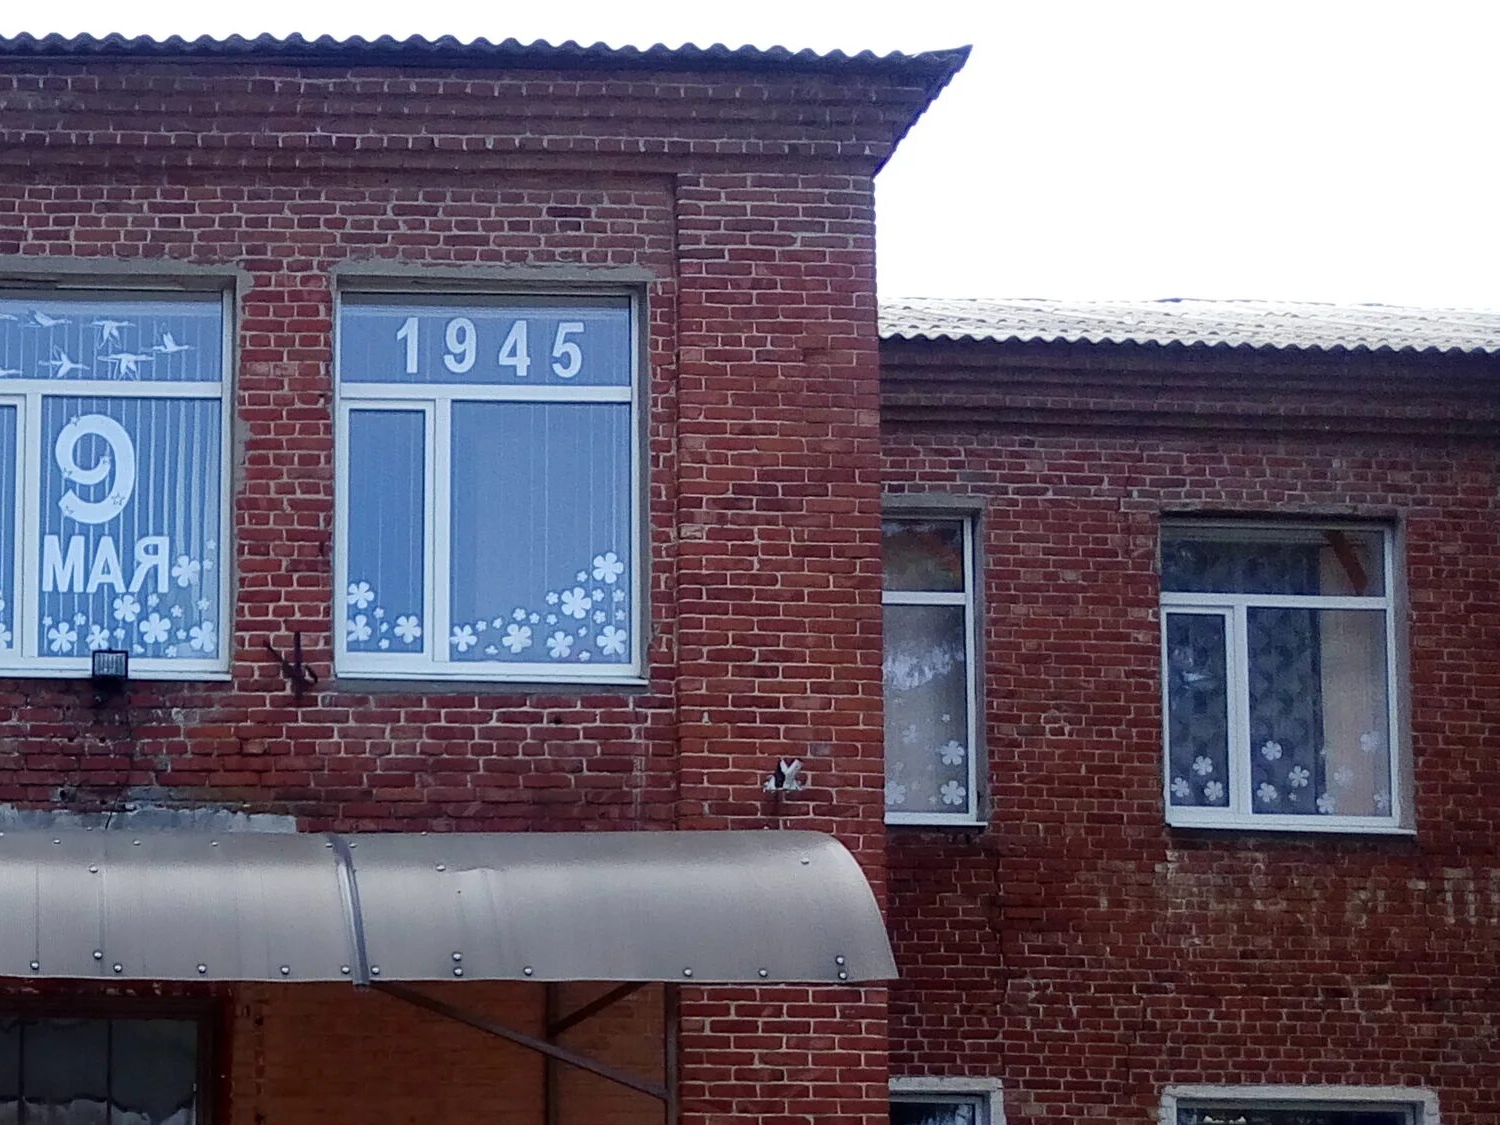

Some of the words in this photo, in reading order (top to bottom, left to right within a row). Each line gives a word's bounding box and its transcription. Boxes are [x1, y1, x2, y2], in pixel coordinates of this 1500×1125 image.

[395, 316, 586, 379] 1945
[54, 413, 136, 525] 9
[42, 535, 170, 594] МАЯ
